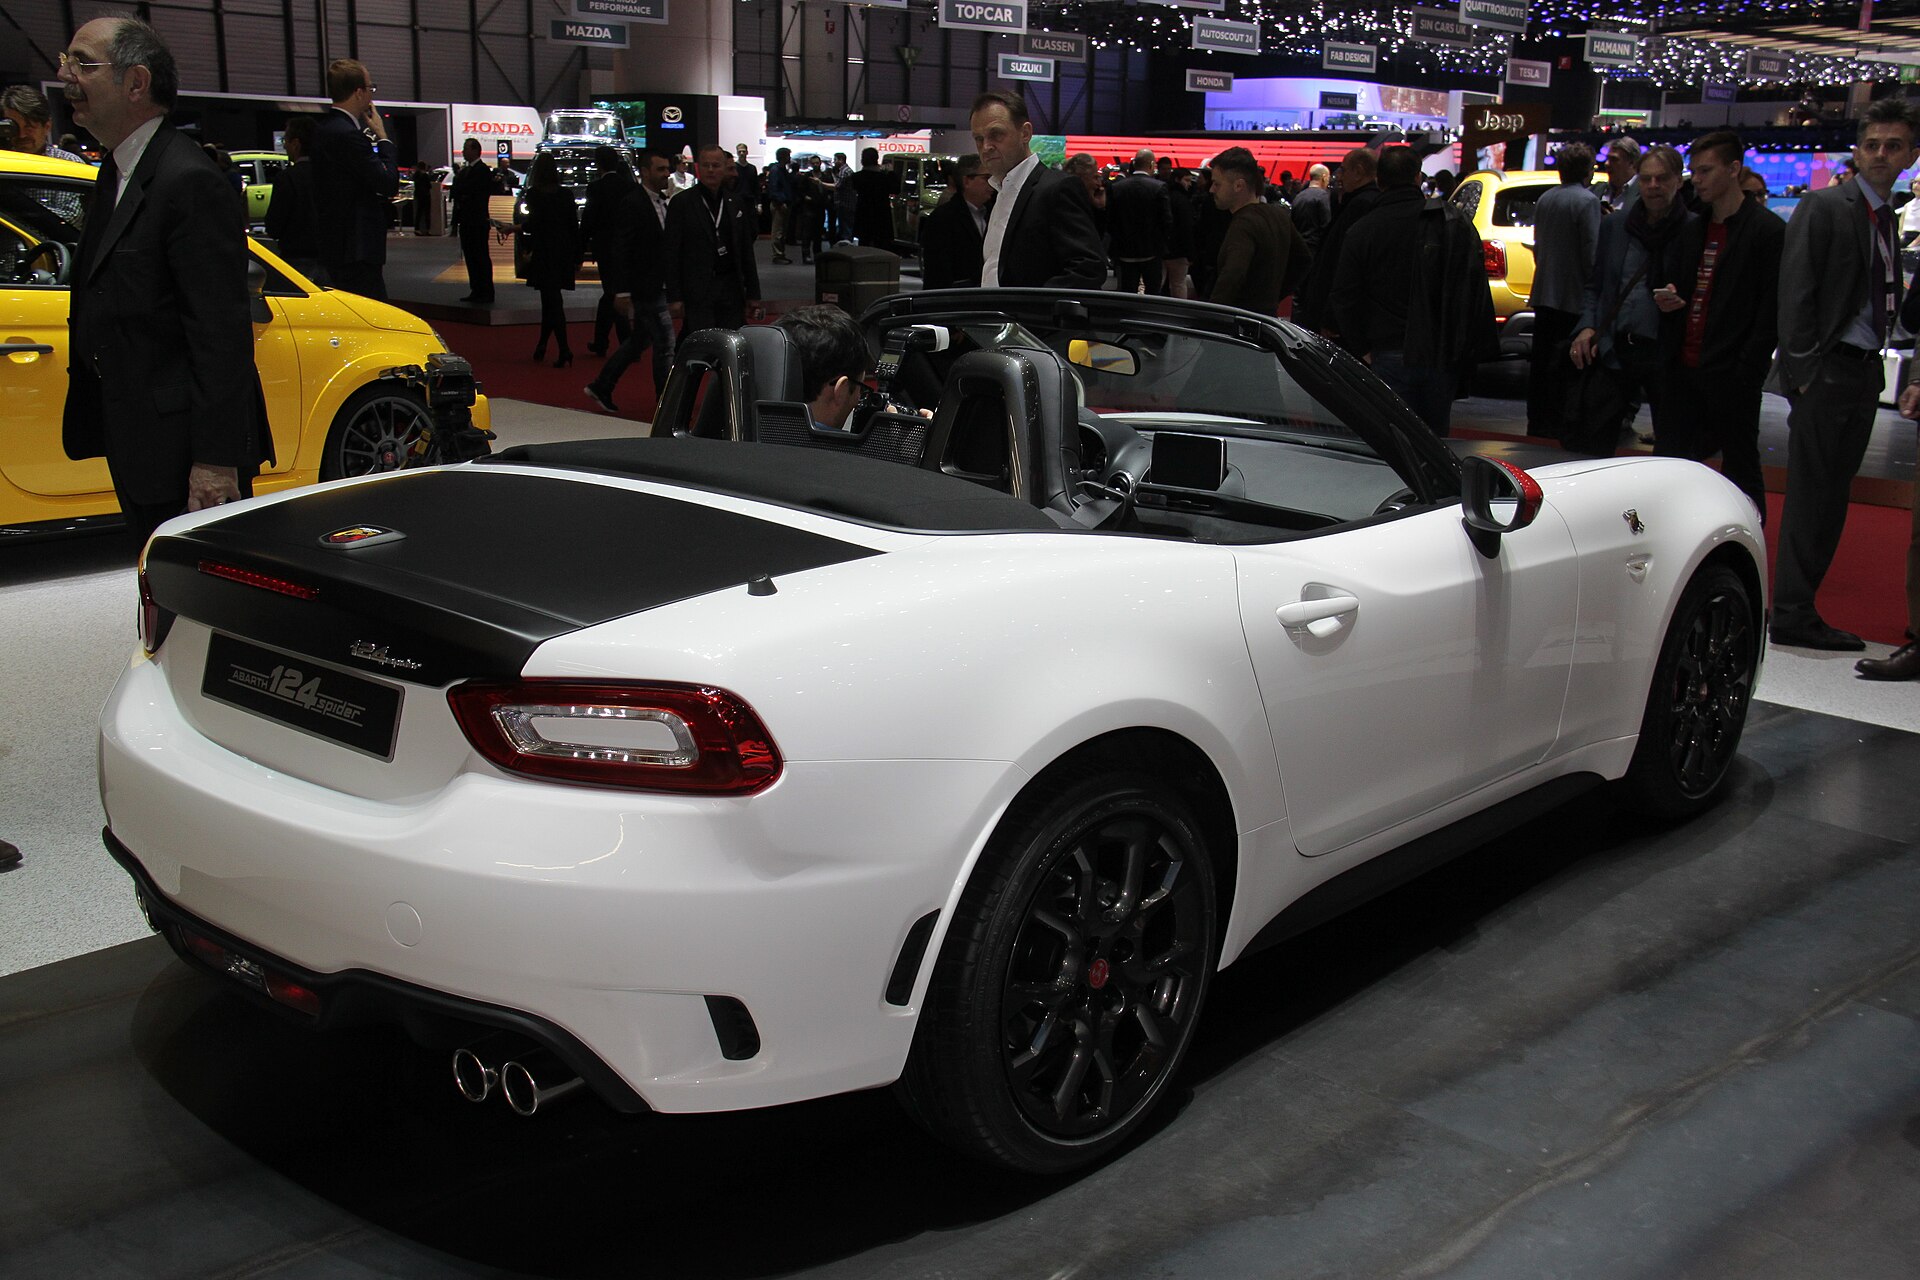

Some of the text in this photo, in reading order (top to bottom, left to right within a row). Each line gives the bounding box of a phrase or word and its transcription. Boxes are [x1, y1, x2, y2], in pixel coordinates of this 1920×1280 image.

[589, 2, 652, 15] PERFORMANCE
[955, 4, 1013, 22] TOPCAR
[1465, 1, 1524, 18] QUATTRORUOTE
[565, 25, 612, 39] MAZDA
[1420, 19, 1467, 35] SIN CARS UK
[1200, 29, 1253, 43] AUTOSCOUT 24
[1031, 38, 1075, 53] KLASSEN
[1593, 40, 1630, 56] HAMANN
[1330, 50, 1370, 63] FAB DESIGN
[1010, 62, 1042, 74] SUZUKI
[1519, 67, 1540, 79] TESLA
[1759, 60, 1780, 72] ISUZU
[1196, 76, 1224, 87] HONDA
[462, 122, 535, 135] HONDA
[1477, 110, 1524, 133] Jeep
[878, 142, 926, 153] HONDA
[232, 665, 361, 720] ABARTH 124 spider
